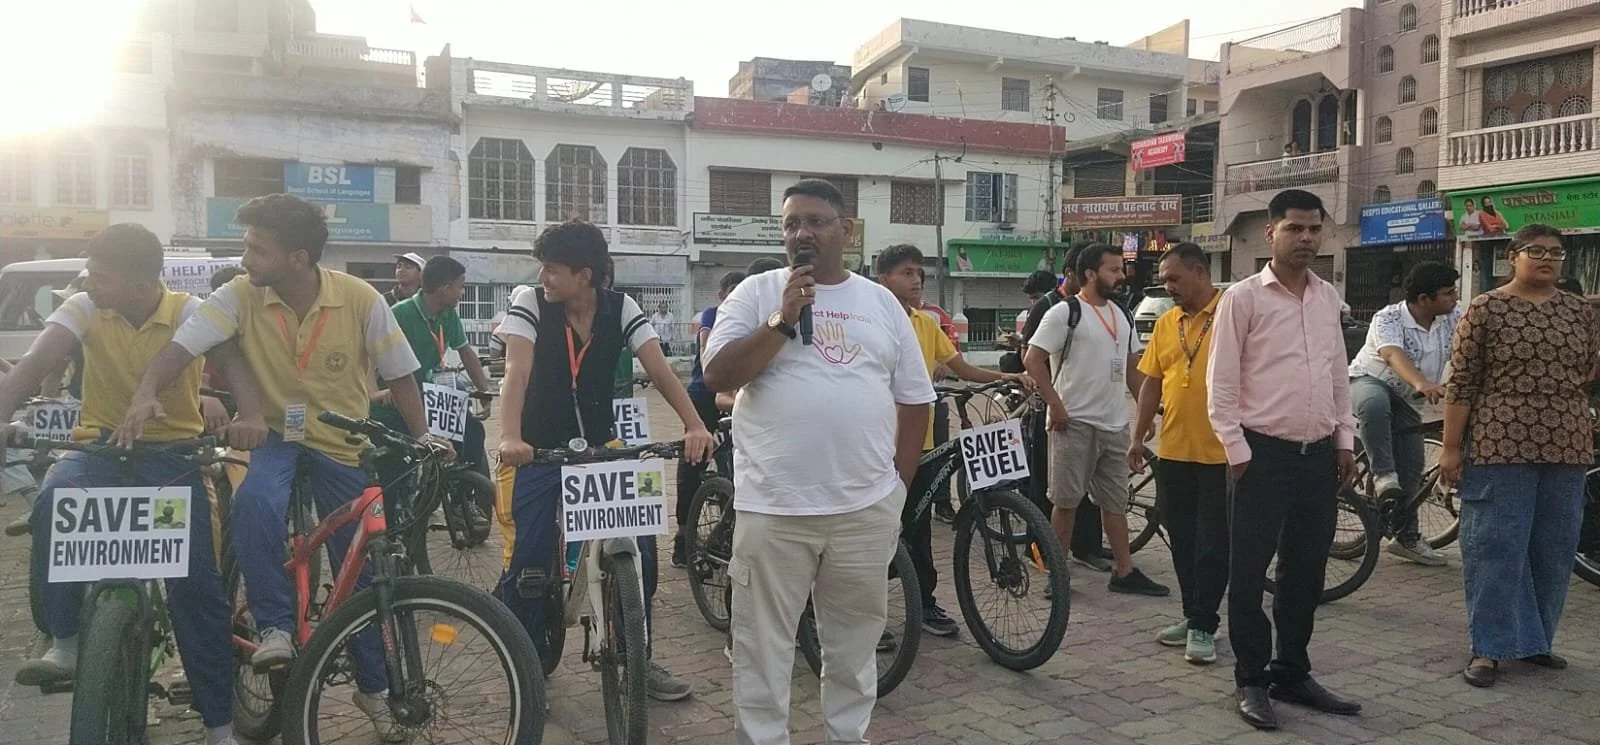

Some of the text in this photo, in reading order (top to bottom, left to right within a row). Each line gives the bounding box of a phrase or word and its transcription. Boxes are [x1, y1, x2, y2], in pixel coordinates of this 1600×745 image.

[308, 166, 351, 185] BSL
[1062, 200, 1178, 214] जय नारायण प्रहलाद राय
[1362, 208, 1380, 217] DEEPTI
[1381, 205, 1417, 215] EDUCATIONAL
[1524, 209, 1577, 221] PATANJALI
[328, 227, 371, 236] nguages
[172, 265, 206, 277] HELP
[184, 278, 209, 286] SOCIET
[826, 310, 850, 320] Help
[427, 389, 458, 414] SAVE
[36, 409, 80, 430] SAV
[428, 409, 464, 435] FUEL
[619, 422, 648, 439] EL
[963, 429, 1008, 459] SAVE
[967, 450, 1025, 482] FUEL
[564, 471, 636, 505] SAVE
[55, 496, 151, 534] SAVE
[566, 504, 663, 532] ENVIRONMENT
[53, 538, 184, 567] ENVIRONMENT
